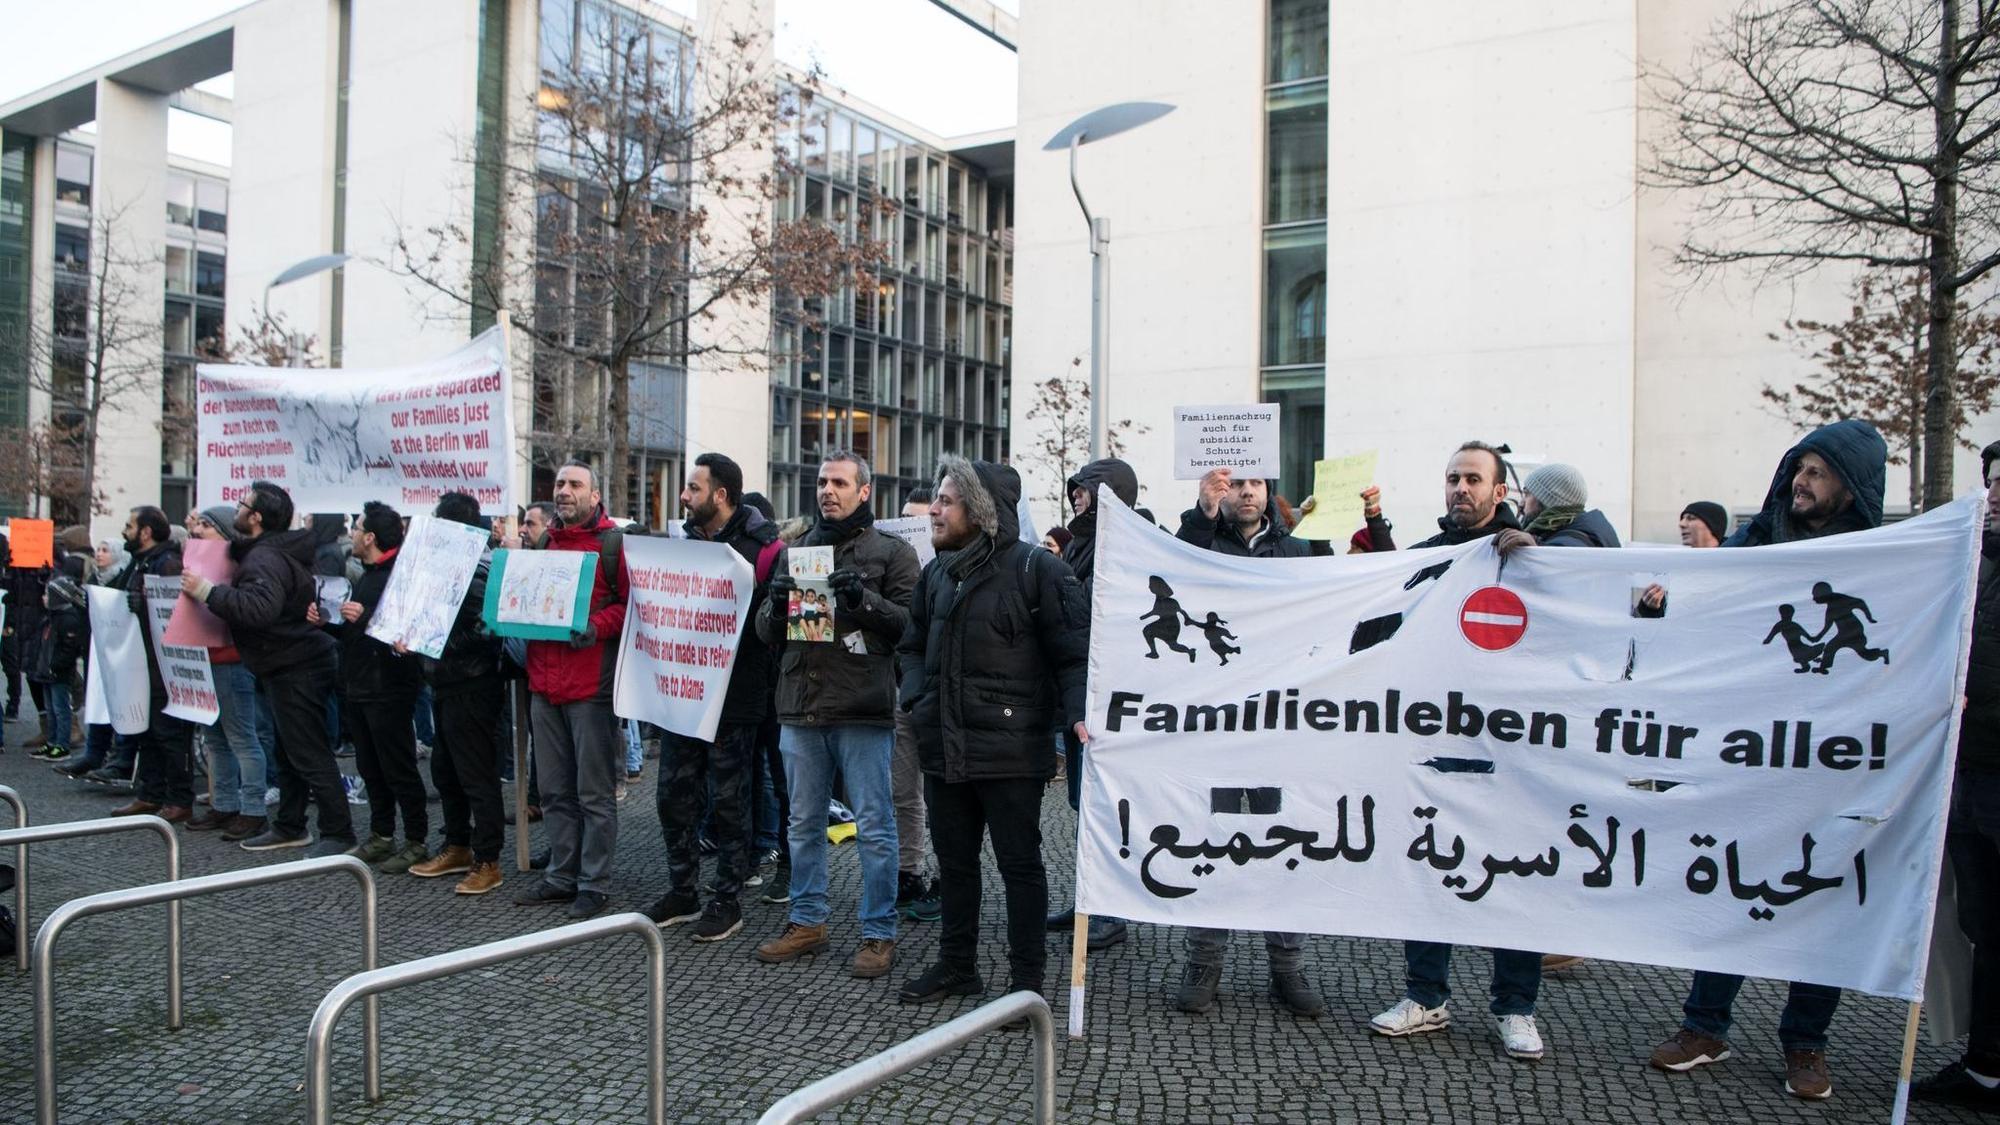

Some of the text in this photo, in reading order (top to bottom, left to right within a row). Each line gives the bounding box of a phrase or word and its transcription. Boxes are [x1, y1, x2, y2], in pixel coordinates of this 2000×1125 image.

[203, 399, 222, 414] der
[391, 402, 490, 428] our Families just
[1181, 412, 1272, 422] Familiennachzug
[223, 422, 241, 435] zum
[1202, 424, 1251, 433] auch für
[390, 429, 489, 455] as the Berlin wall
[1199, 435, 1254, 444] subsidiär
[1205, 447, 1248, 455] Schutz-
[230, 462, 287, 478] ist eine neue
[400, 459, 488, 481] has divided your
[1190, 458, 1261, 467] berechtigte!
[478, 484, 502, 505] past
[652, 568, 661, 591] of
[661, 568, 690, 599] stopping
[691, 571, 703, 597] the
[704, 574, 737, 603] reunion,
[661, 607, 677, 628] arms
[678, 608, 693, 630] that
[694, 609, 737, 637] destroyed
[661, 638, 673, 662] and
[675, 641, 696, 666] made
[697, 643, 708, 666] us
[671, 674, 679, 697] to
[681, 674, 705, 701] blame
[1105, 689, 1889, 771] Familienleben für alle!
[1117, 794, 1867, 922] الحياة الأسرية للجميع!
